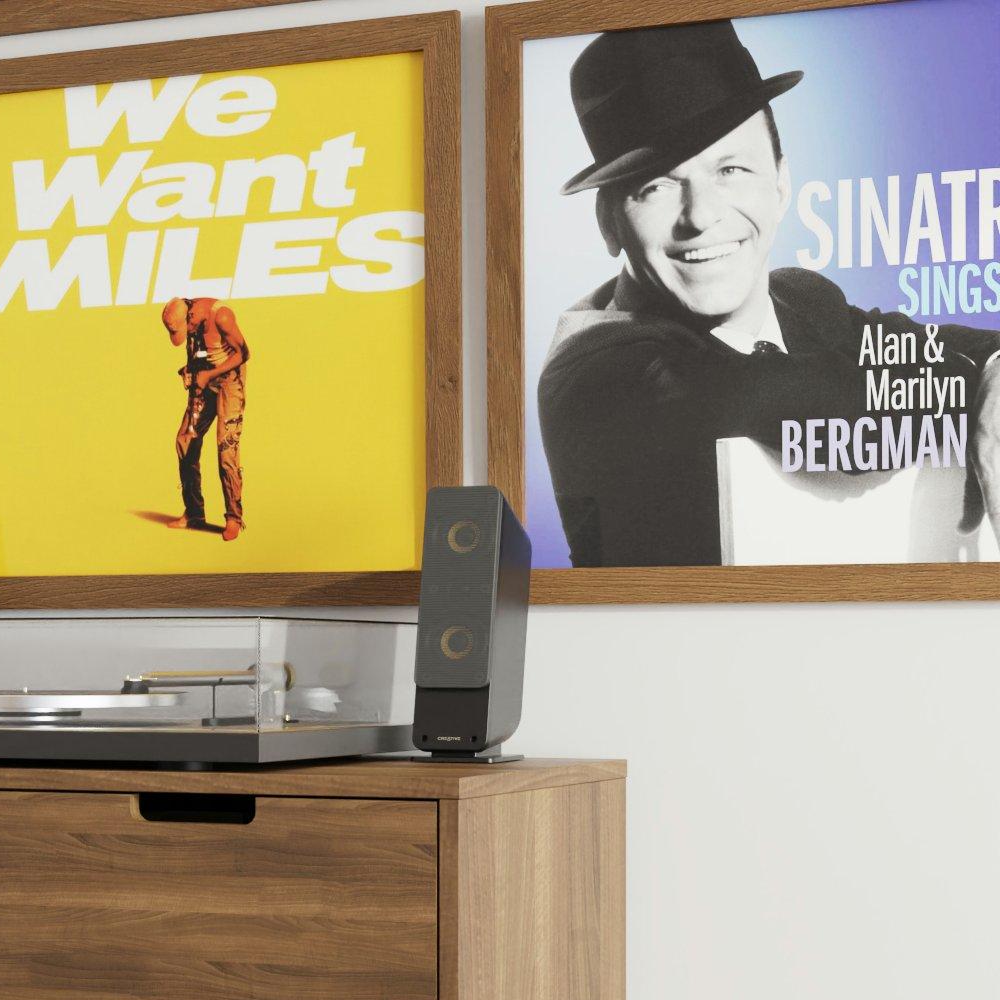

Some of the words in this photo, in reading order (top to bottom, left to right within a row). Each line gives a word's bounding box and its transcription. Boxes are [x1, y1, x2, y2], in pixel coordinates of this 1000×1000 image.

[64, 74, 278, 149] We
[12, 131, 365, 231] Want
[898, 262, 1000, 317] SINGS
[859, 324, 917, 367] Alan
[923, 323, 945, 363] &
[866, 366, 966, 419] Marilyn
[781, 413, 968, 473] BERGMAN
